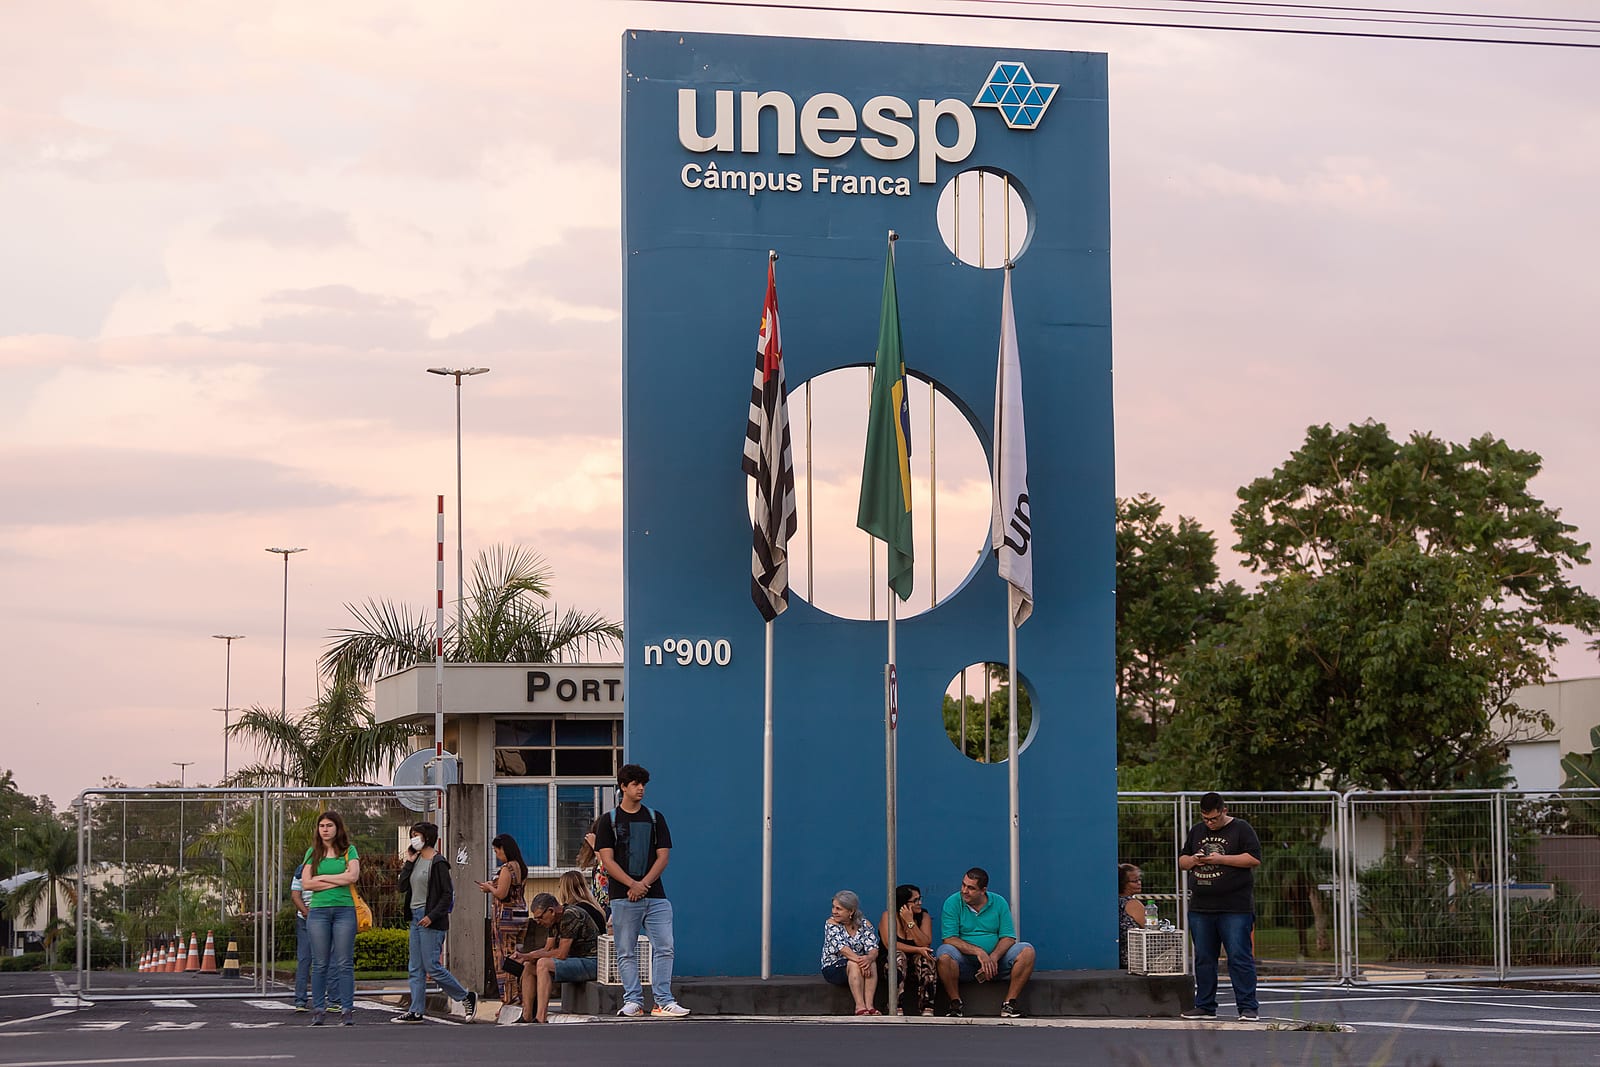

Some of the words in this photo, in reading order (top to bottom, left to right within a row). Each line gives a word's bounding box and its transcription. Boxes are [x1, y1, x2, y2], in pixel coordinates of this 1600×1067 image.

[678, 88, 977, 184] unesp
[680, 161, 803, 196] Câmpus
[811, 167, 912, 196] Franca
[527, 671, 624, 702] PORT
